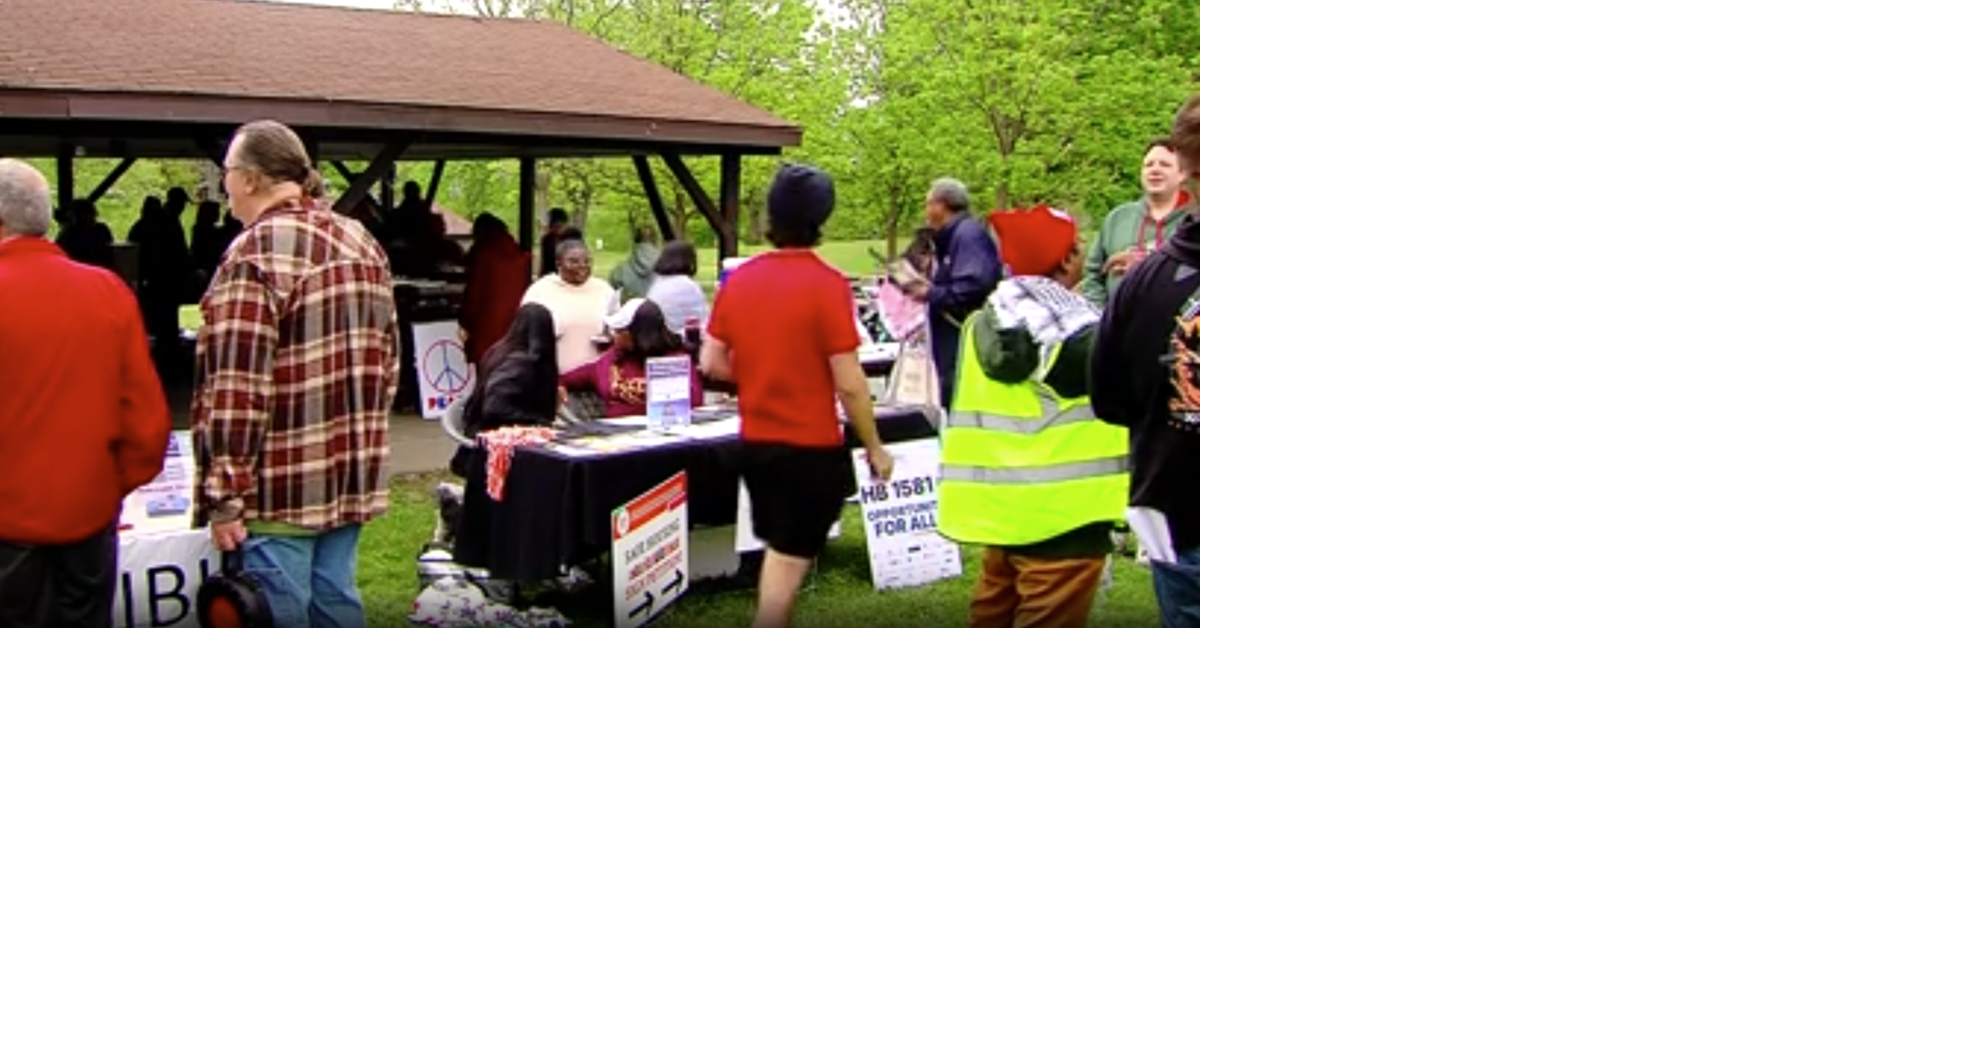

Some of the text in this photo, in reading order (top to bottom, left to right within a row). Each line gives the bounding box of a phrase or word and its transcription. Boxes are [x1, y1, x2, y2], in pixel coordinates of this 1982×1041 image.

[861, 475, 933, 503] HB 1581
[867, 500, 938, 521] OPPORTUNIT
[874, 512, 938, 538] FOR ALL
